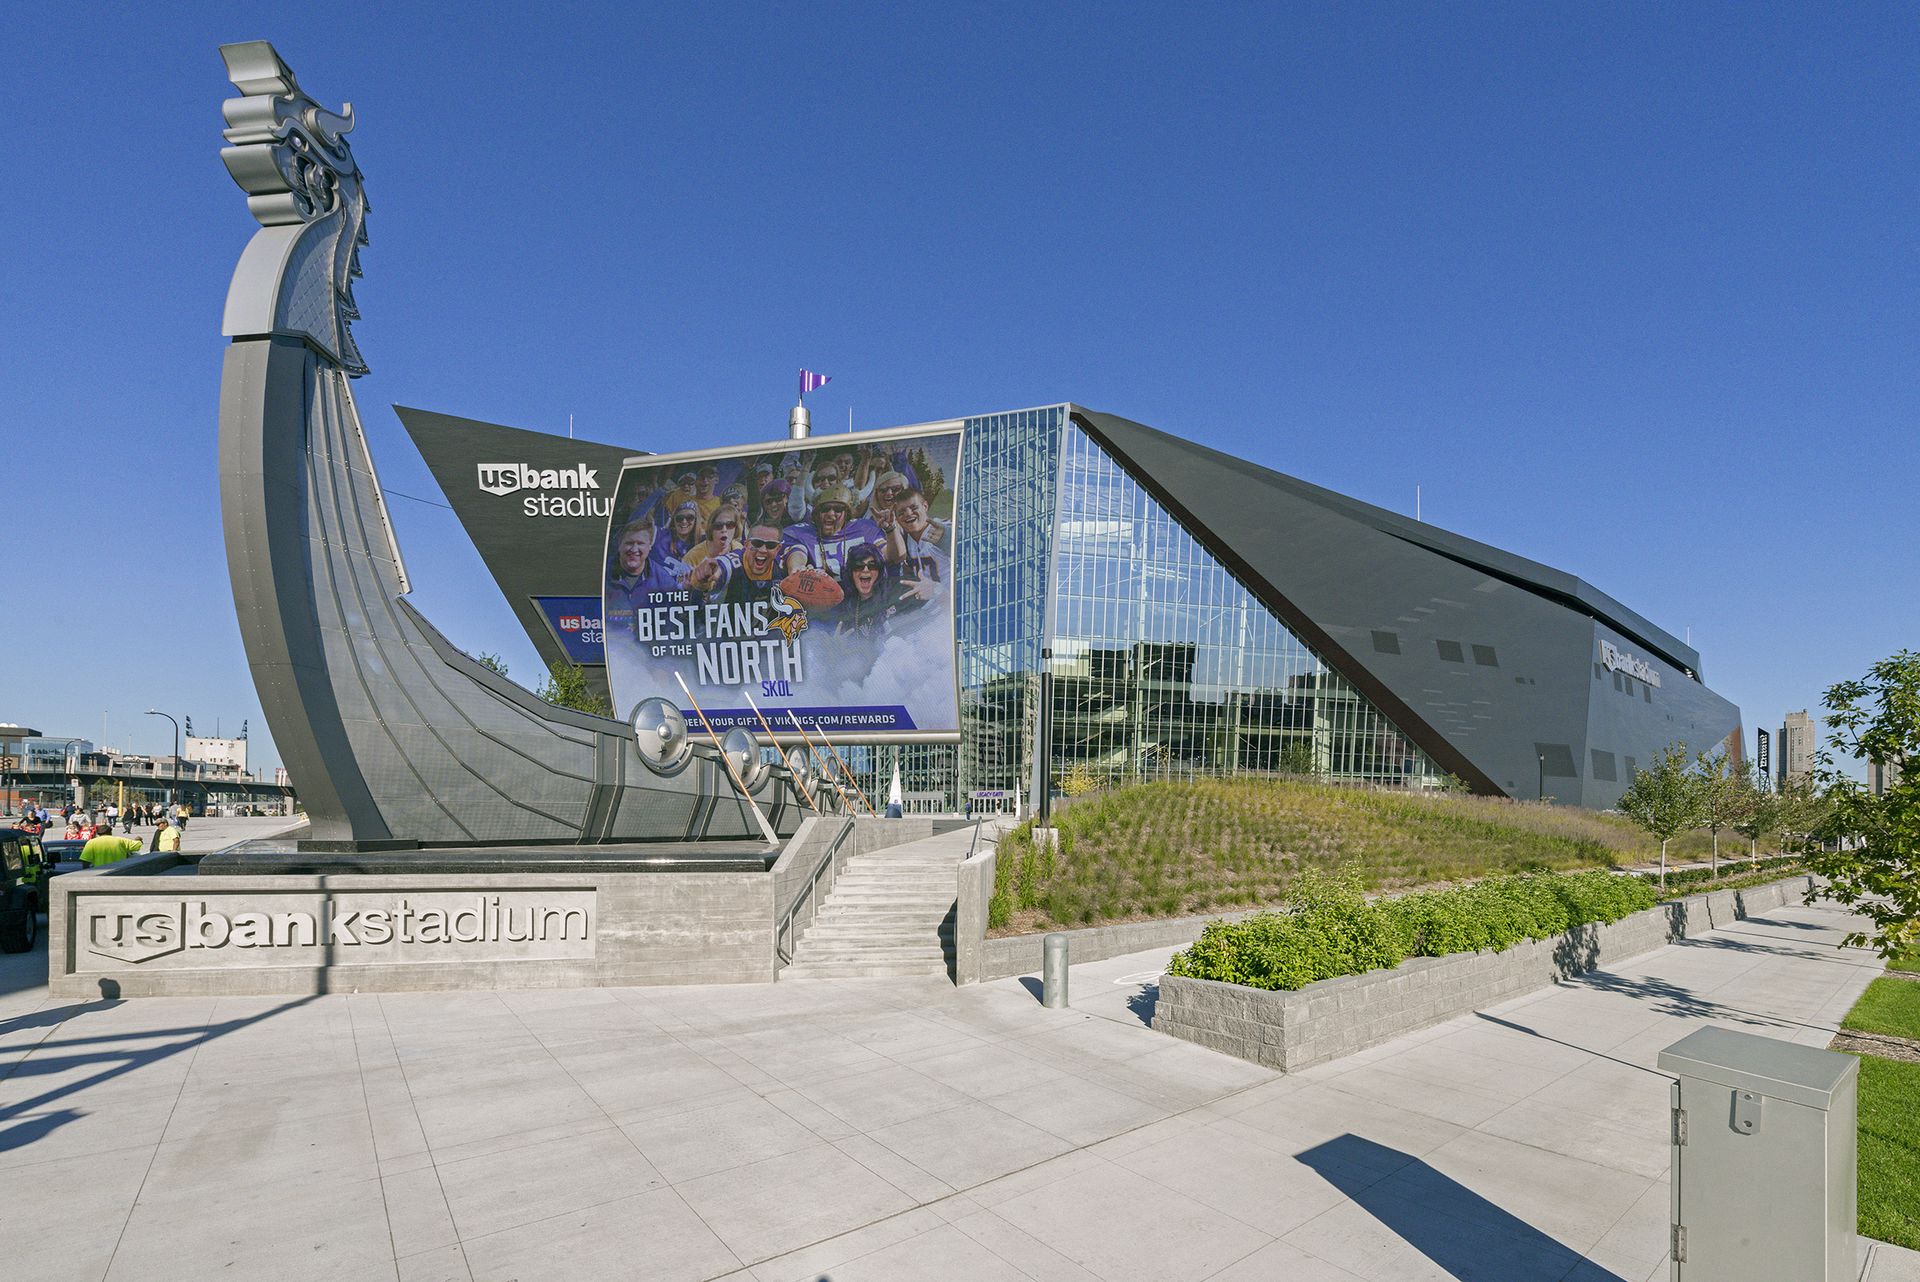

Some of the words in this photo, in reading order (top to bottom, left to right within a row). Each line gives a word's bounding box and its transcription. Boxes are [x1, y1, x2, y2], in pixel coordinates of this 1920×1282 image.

[523, 491, 614, 517] stadiu
[648, 593, 663, 604] TO
[666, 591, 689, 602] THE
[560, 616, 603, 630] usba
[638, 605, 699, 641] BEST
[704, 601, 769, 638] FANS
[652, 645, 667, 657] OF
[670, 644, 692, 656] THE
[696, 638, 804, 685] NORTH
[761, 680, 794, 697] SKOL
[709, 717, 735, 726] YOUR
[738, 716, 758, 726] GIFT
